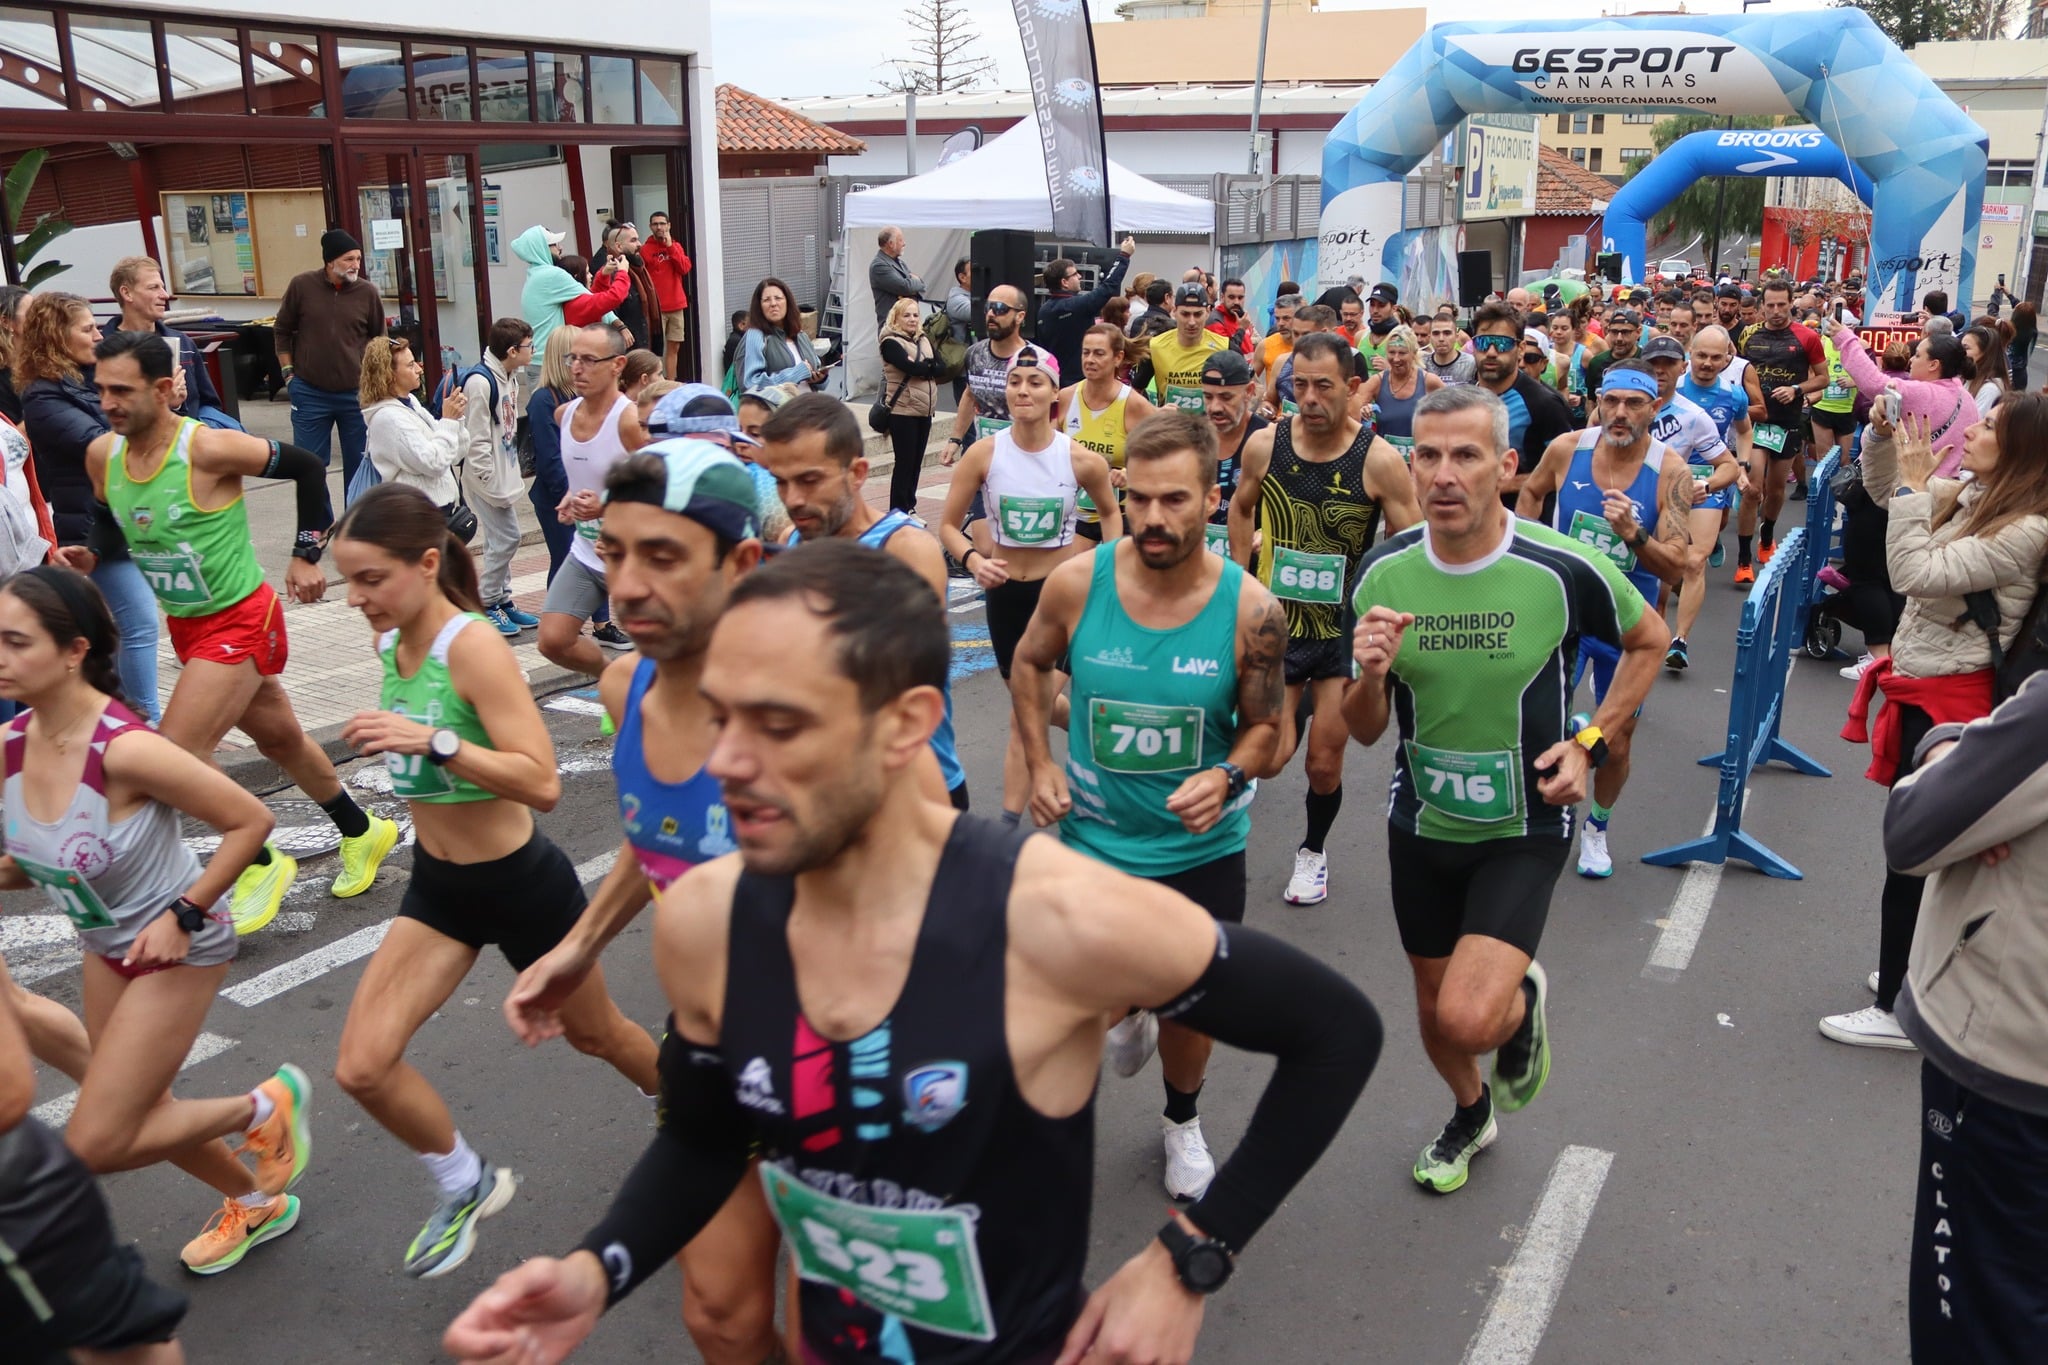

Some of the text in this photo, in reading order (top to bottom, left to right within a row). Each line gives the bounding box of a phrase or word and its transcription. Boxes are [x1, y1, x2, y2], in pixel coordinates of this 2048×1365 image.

[1512, 46, 1736, 73] GESPORT
[1534, 73, 1696, 89] CANARIAS
[1531, 96, 1717, 105] WWW.GESPORTCANARIAS.COM
[1486, 135, 1532, 160] TACORONTE
[1716, 132, 1825, 148] BROOKS
[1981, 205, 2008, 216] PARKING
[1172, 395, 1202, 409] 729
[1008, 510, 1055, 532] 574
[1579, 528, 1629, 560] 554
[144, 571, 195, 591] 774
[1280, 565, 1336, 590] 688
[1414, 611, 1515, 632] PROHIBIDO
[1419, 632, 1508, 651] RENDIRSE
[1110, 724, 1182, 756] 701
[1424, 766, 1496, 804] 716
[1931, 1161, 1953, 1319] CLATOR
